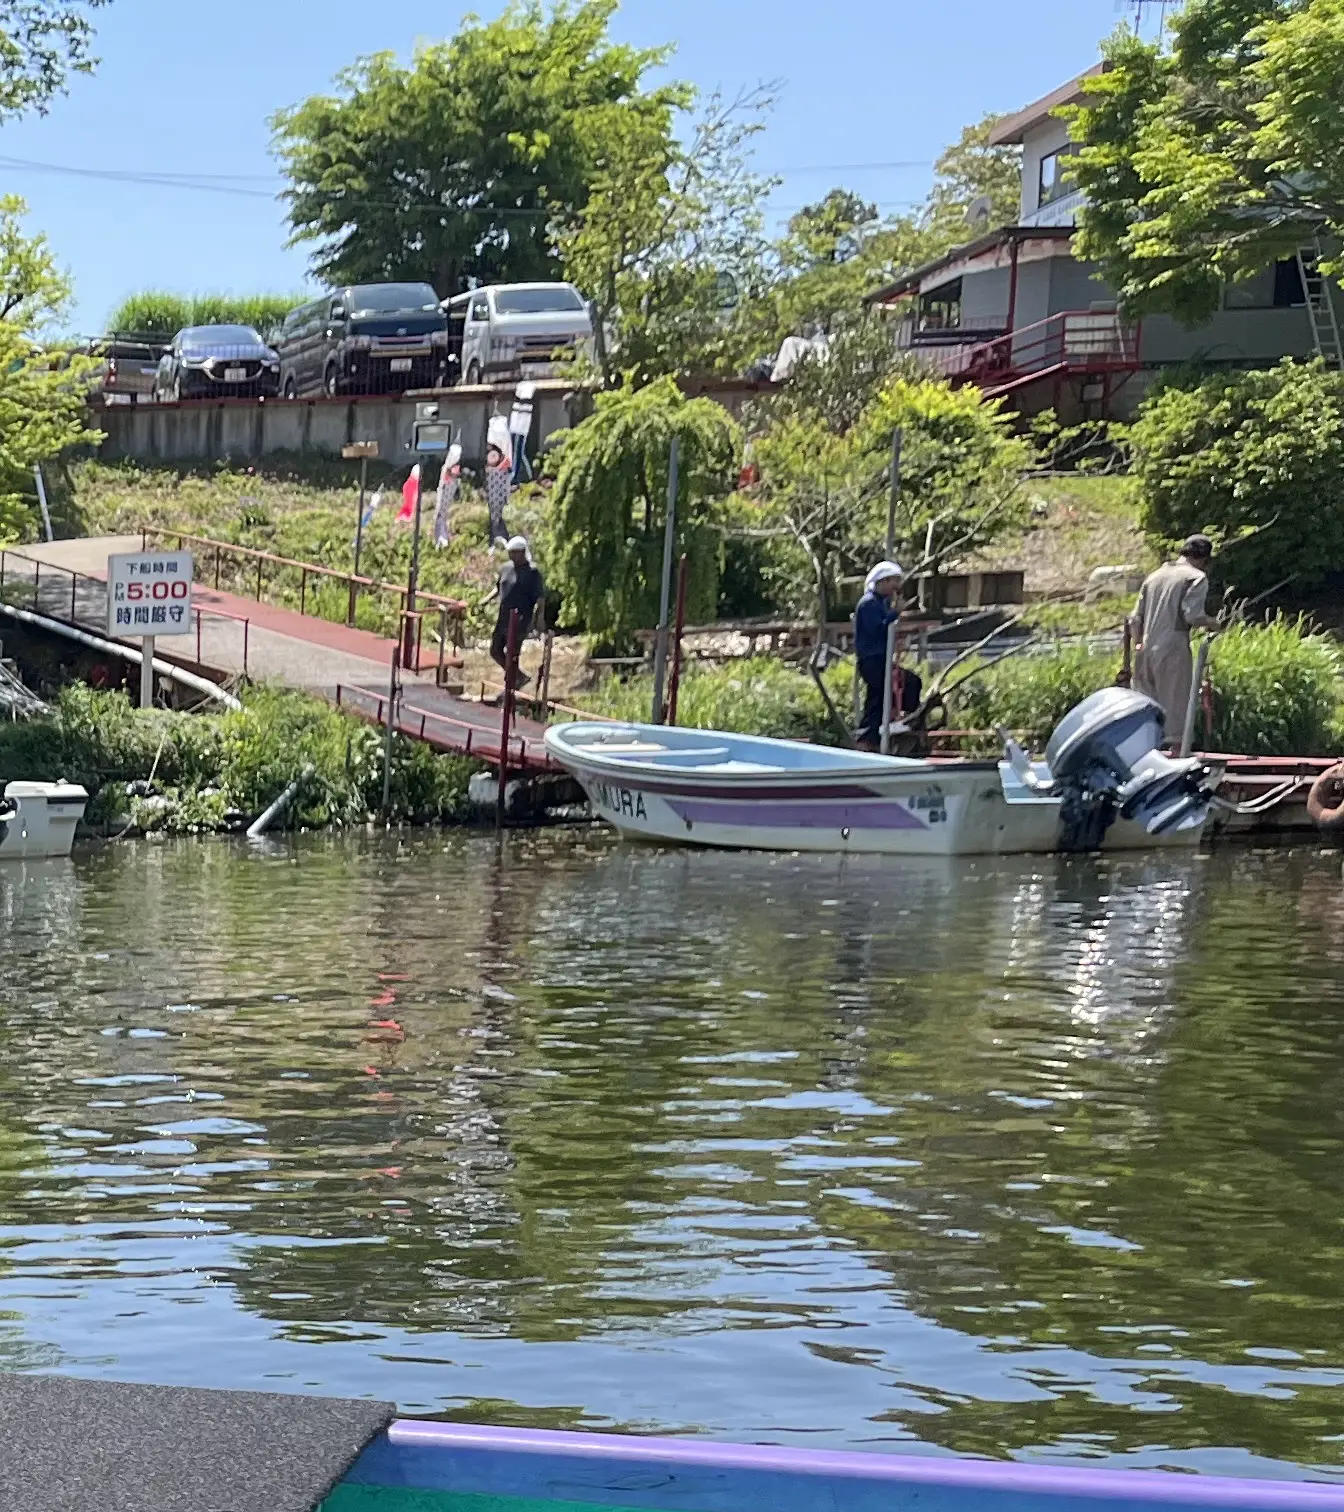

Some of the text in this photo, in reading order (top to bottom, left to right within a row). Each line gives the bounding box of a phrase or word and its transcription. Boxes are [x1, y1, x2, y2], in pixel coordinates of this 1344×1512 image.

[126, 561, 178, 575] 下船時間
[127, 580, 188, 601] 5:00
[116, 604, 185, 625] 時間厳守
